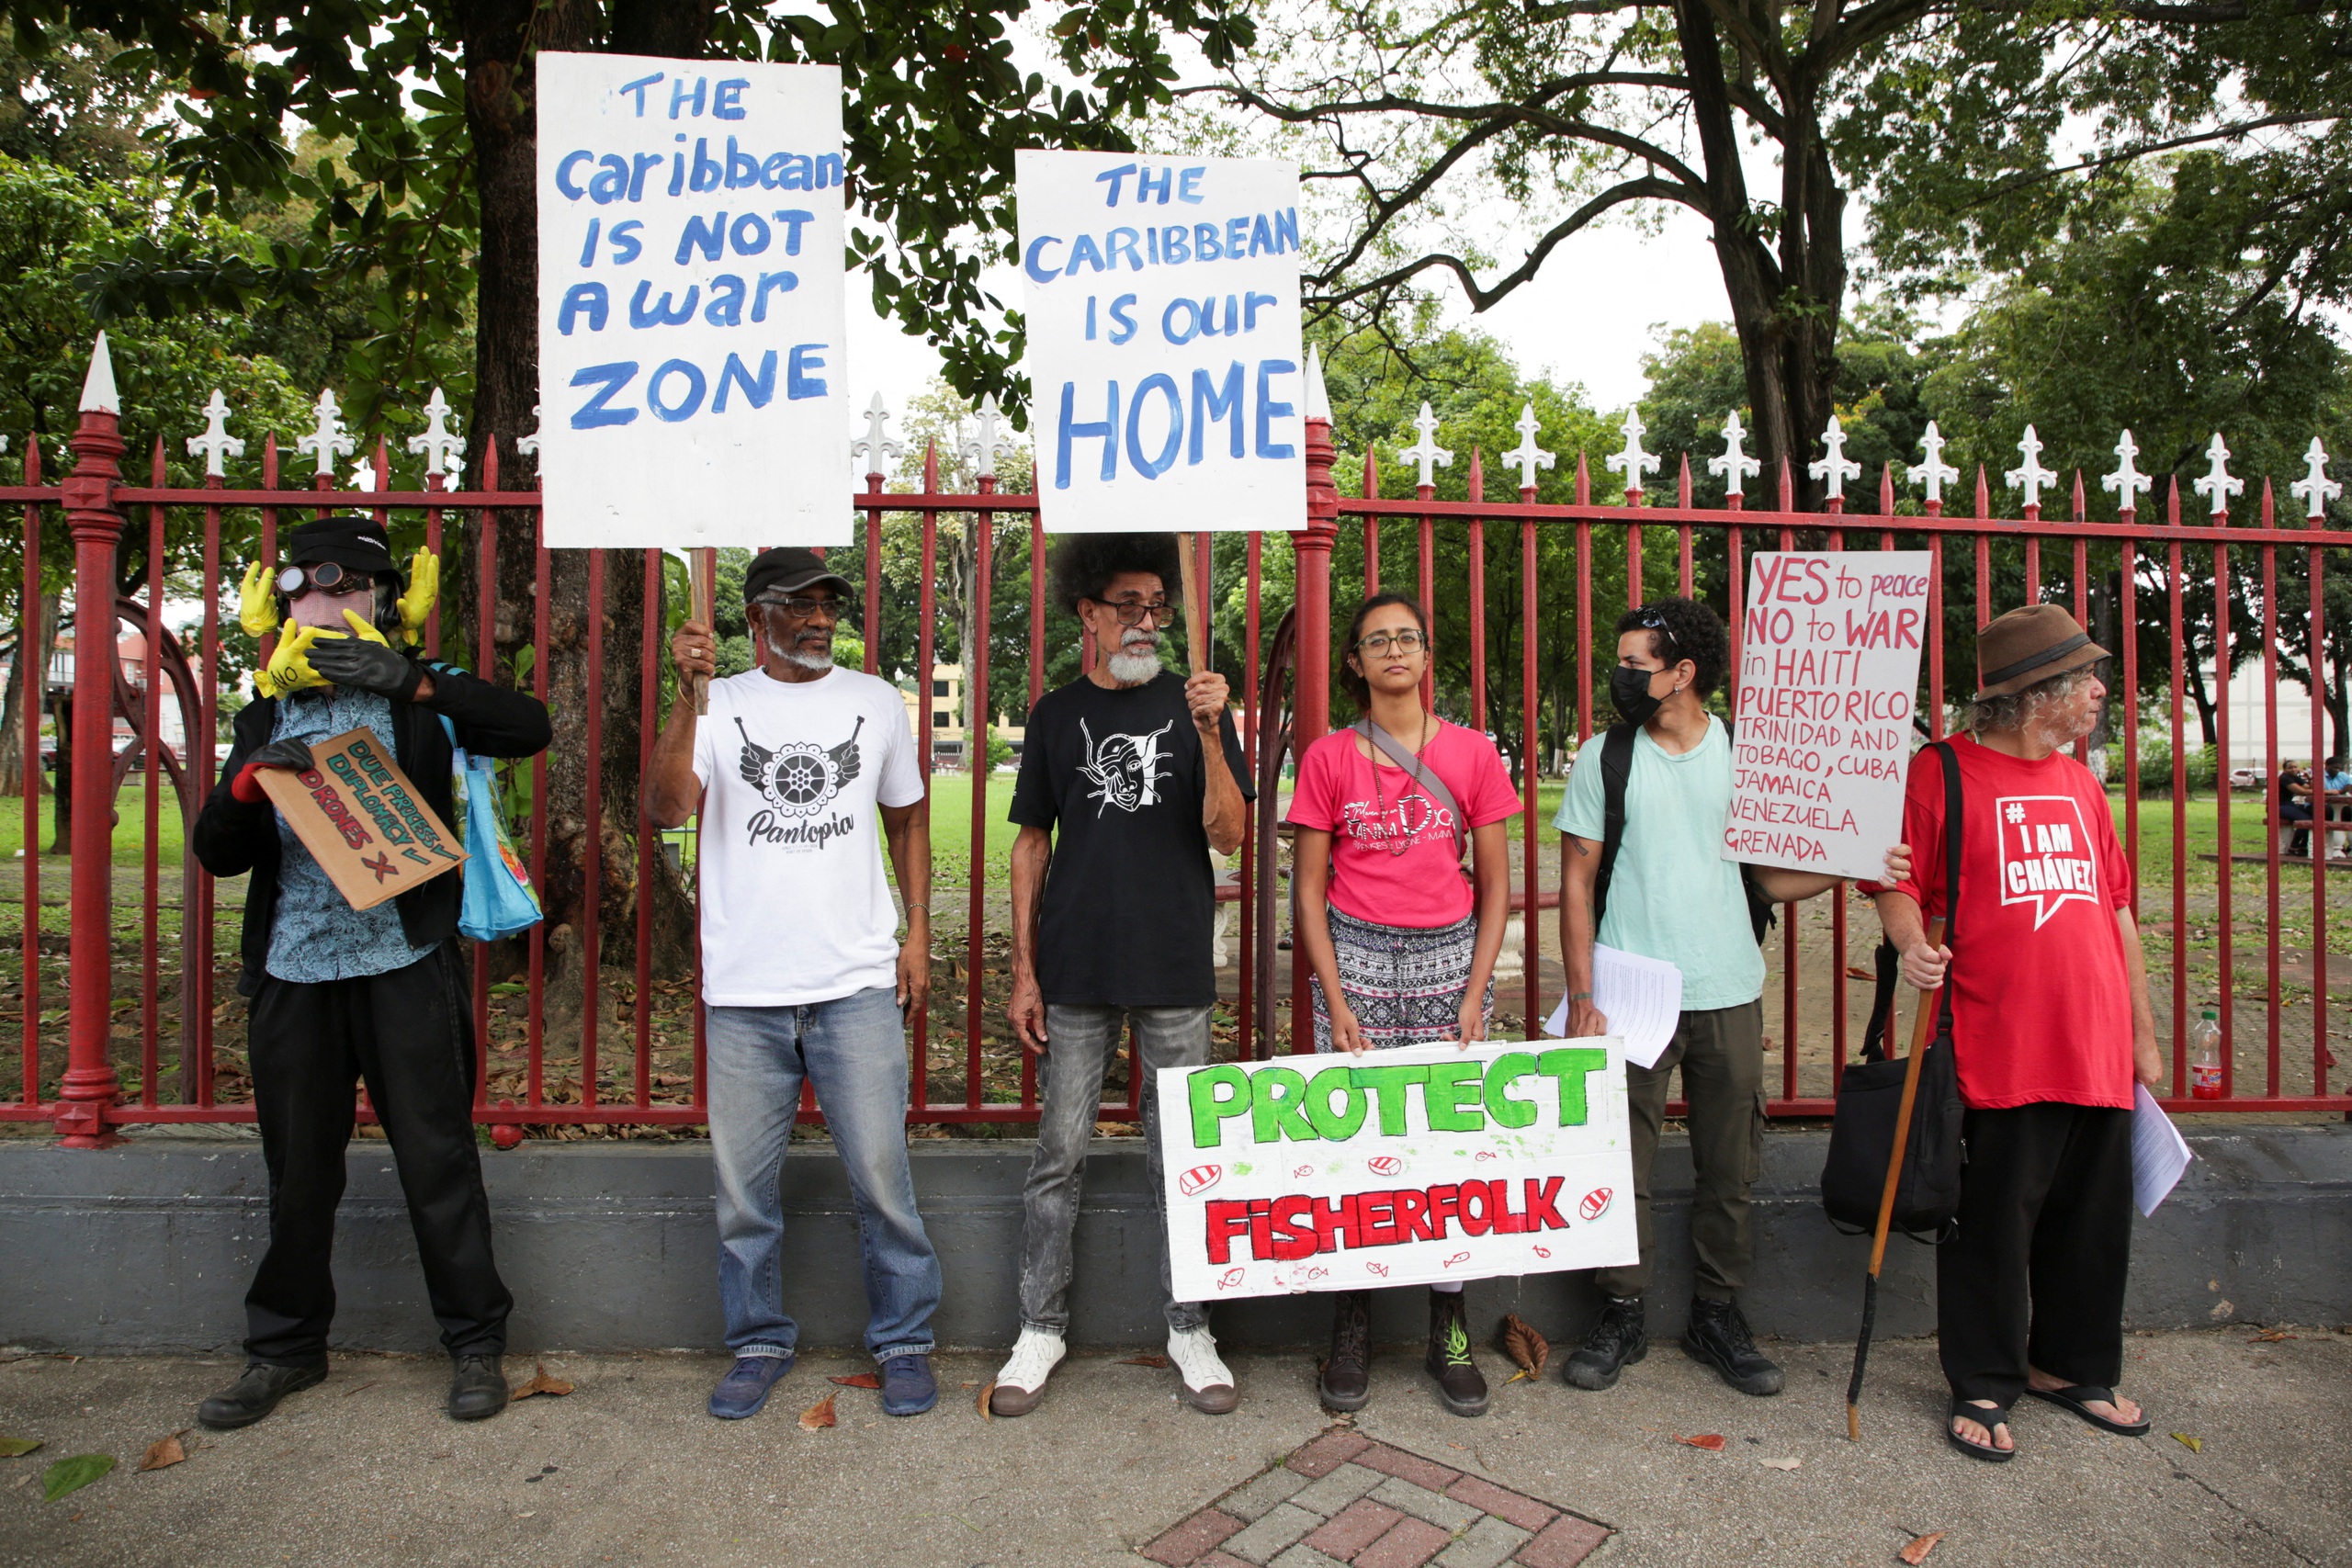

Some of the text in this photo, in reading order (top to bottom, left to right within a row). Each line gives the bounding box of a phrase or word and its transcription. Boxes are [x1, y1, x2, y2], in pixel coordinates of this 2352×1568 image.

[619, 72, 751, 120] THE
[1095, 163, 1207, 208] THE
[580, 209, 815, 267] IS NOT
[1024, 207, 1300, 283] CARIBBEAN
[558, 281, 609, 335] A
[1085, 292, 1137, 346] IS
[570, 344, 829, 430] ZONE
[1055, 359, 1297, 490] HOME
[1754, 555, 1929, 615] YES to peace
[1747, 606, 1920, 650] NO to WAR
[270, 666, 299, 691] NO
[1744, 648, 1862, 687] in HAITI
[1739, 686, 1910, 726] PUERTO RICO
[1738, 716, 1900, 752] TRINIDAD AND
[1735, 769, 1833, 804] JAMAICA
[1838, 755, 1900, 784] CUBA
[296, 767, 374, 851] DRONES
[325, 752, 416, 847] DIPLOMACY
[347, 739, 441, 849] DUE PROCESS
[1729, 795, 1860, 837] VENEZUELA
[2005, 802, 2027, 824] #
[746, 808, 854, 851] Pantopia
[1724, 828, 1828, 862] GRENADA
[2019, 823, 2074, 853] I AM
[2007, 852, 2093, 895] CHÁVEZ
[1187, 1048, 1608, 1149] PROTECT
